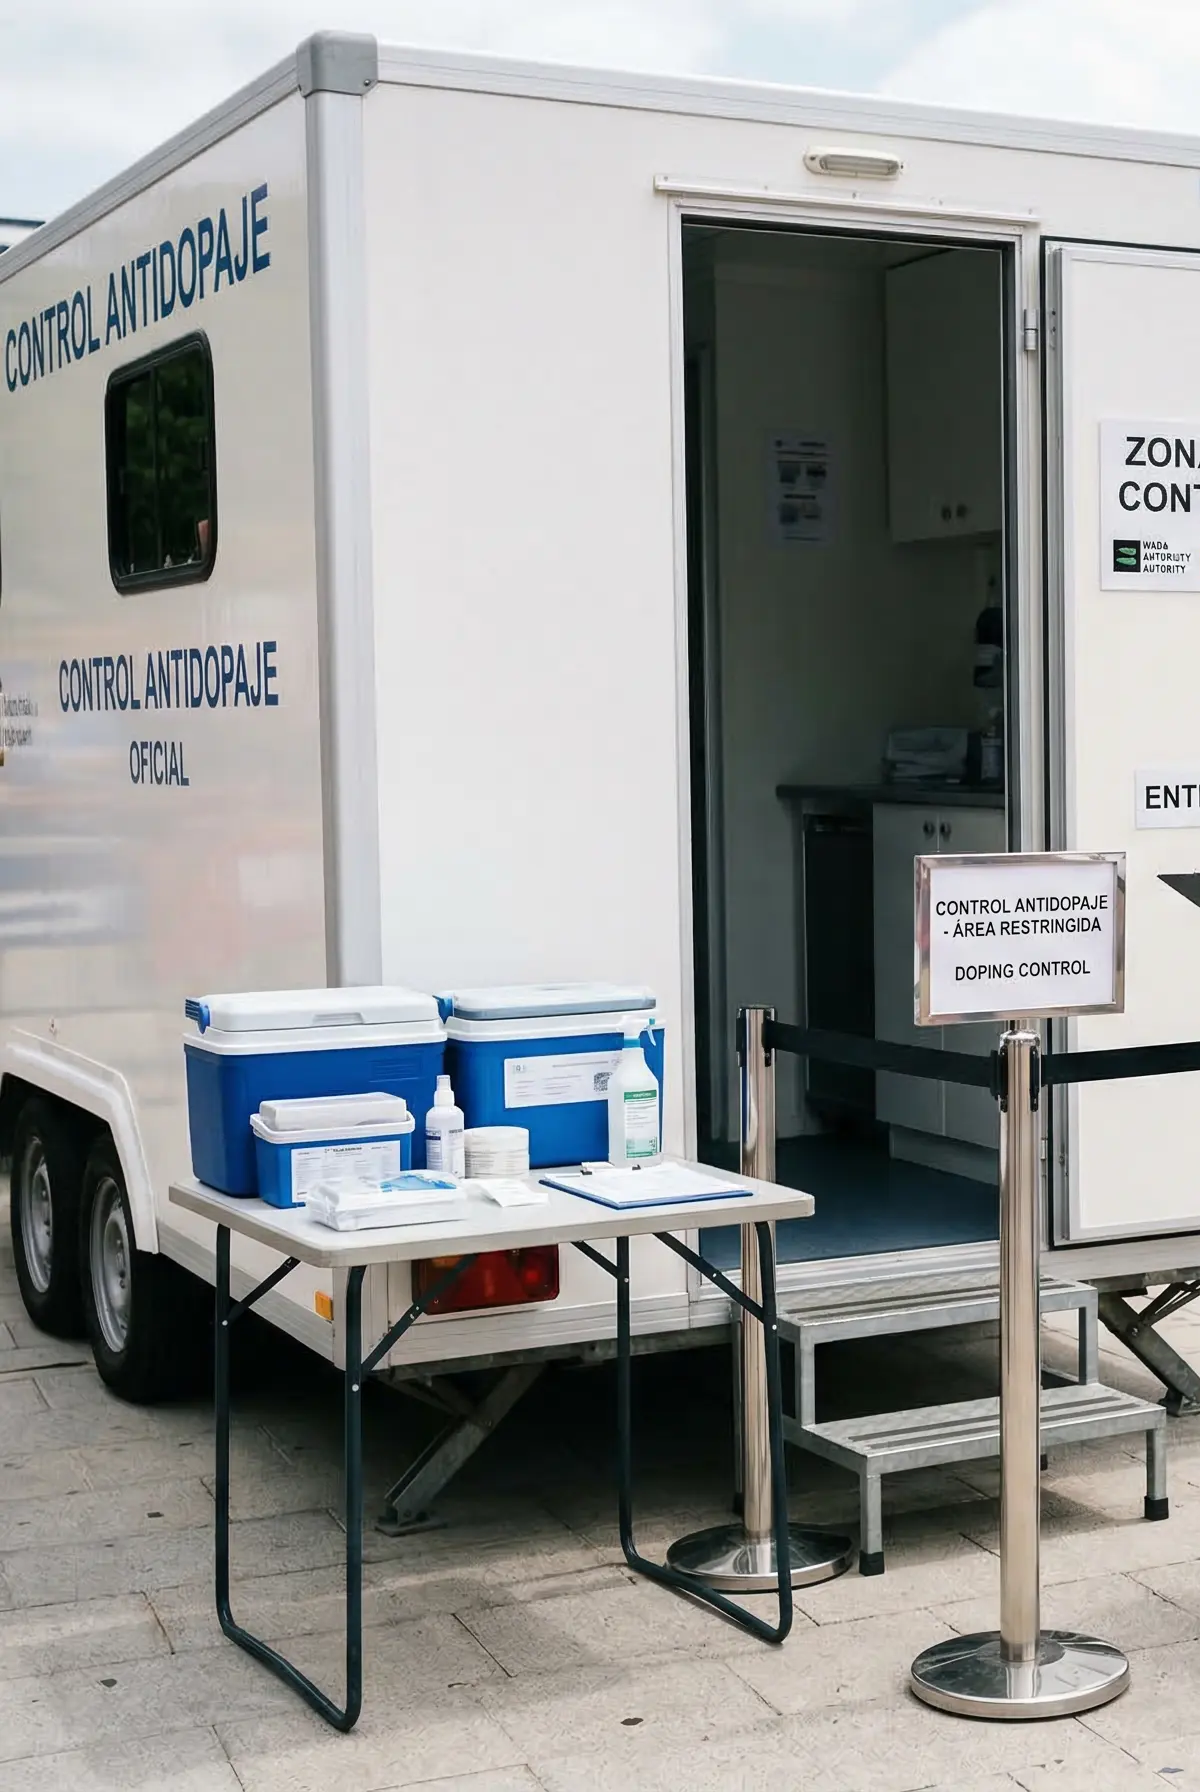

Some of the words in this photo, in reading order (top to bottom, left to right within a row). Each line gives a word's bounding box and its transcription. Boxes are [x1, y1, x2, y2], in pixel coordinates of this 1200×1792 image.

[5, 285, 101, 393] CONTROL
[105, 182, 271, 346] ANTIDOPAJE
[1142, 564, 1186, 574] AUTORITY
[58, 654, 141, 713] CONTROL
[145, 640, 279, 710] ANTIDOPAJE
[129, 740, 190, 787] OFICIAL
[935, 898, 1011, 916] CONTROL
[1014, 894, 1109, 913] ANTIDOPAJE
[953, 918, 996, 938] ÁREA
[999, 916, 1102, 935] RESTRINGIDA
[955, 963, 1014, 981] DOPING
[1018, 960, 1091, 978] CONTROL
